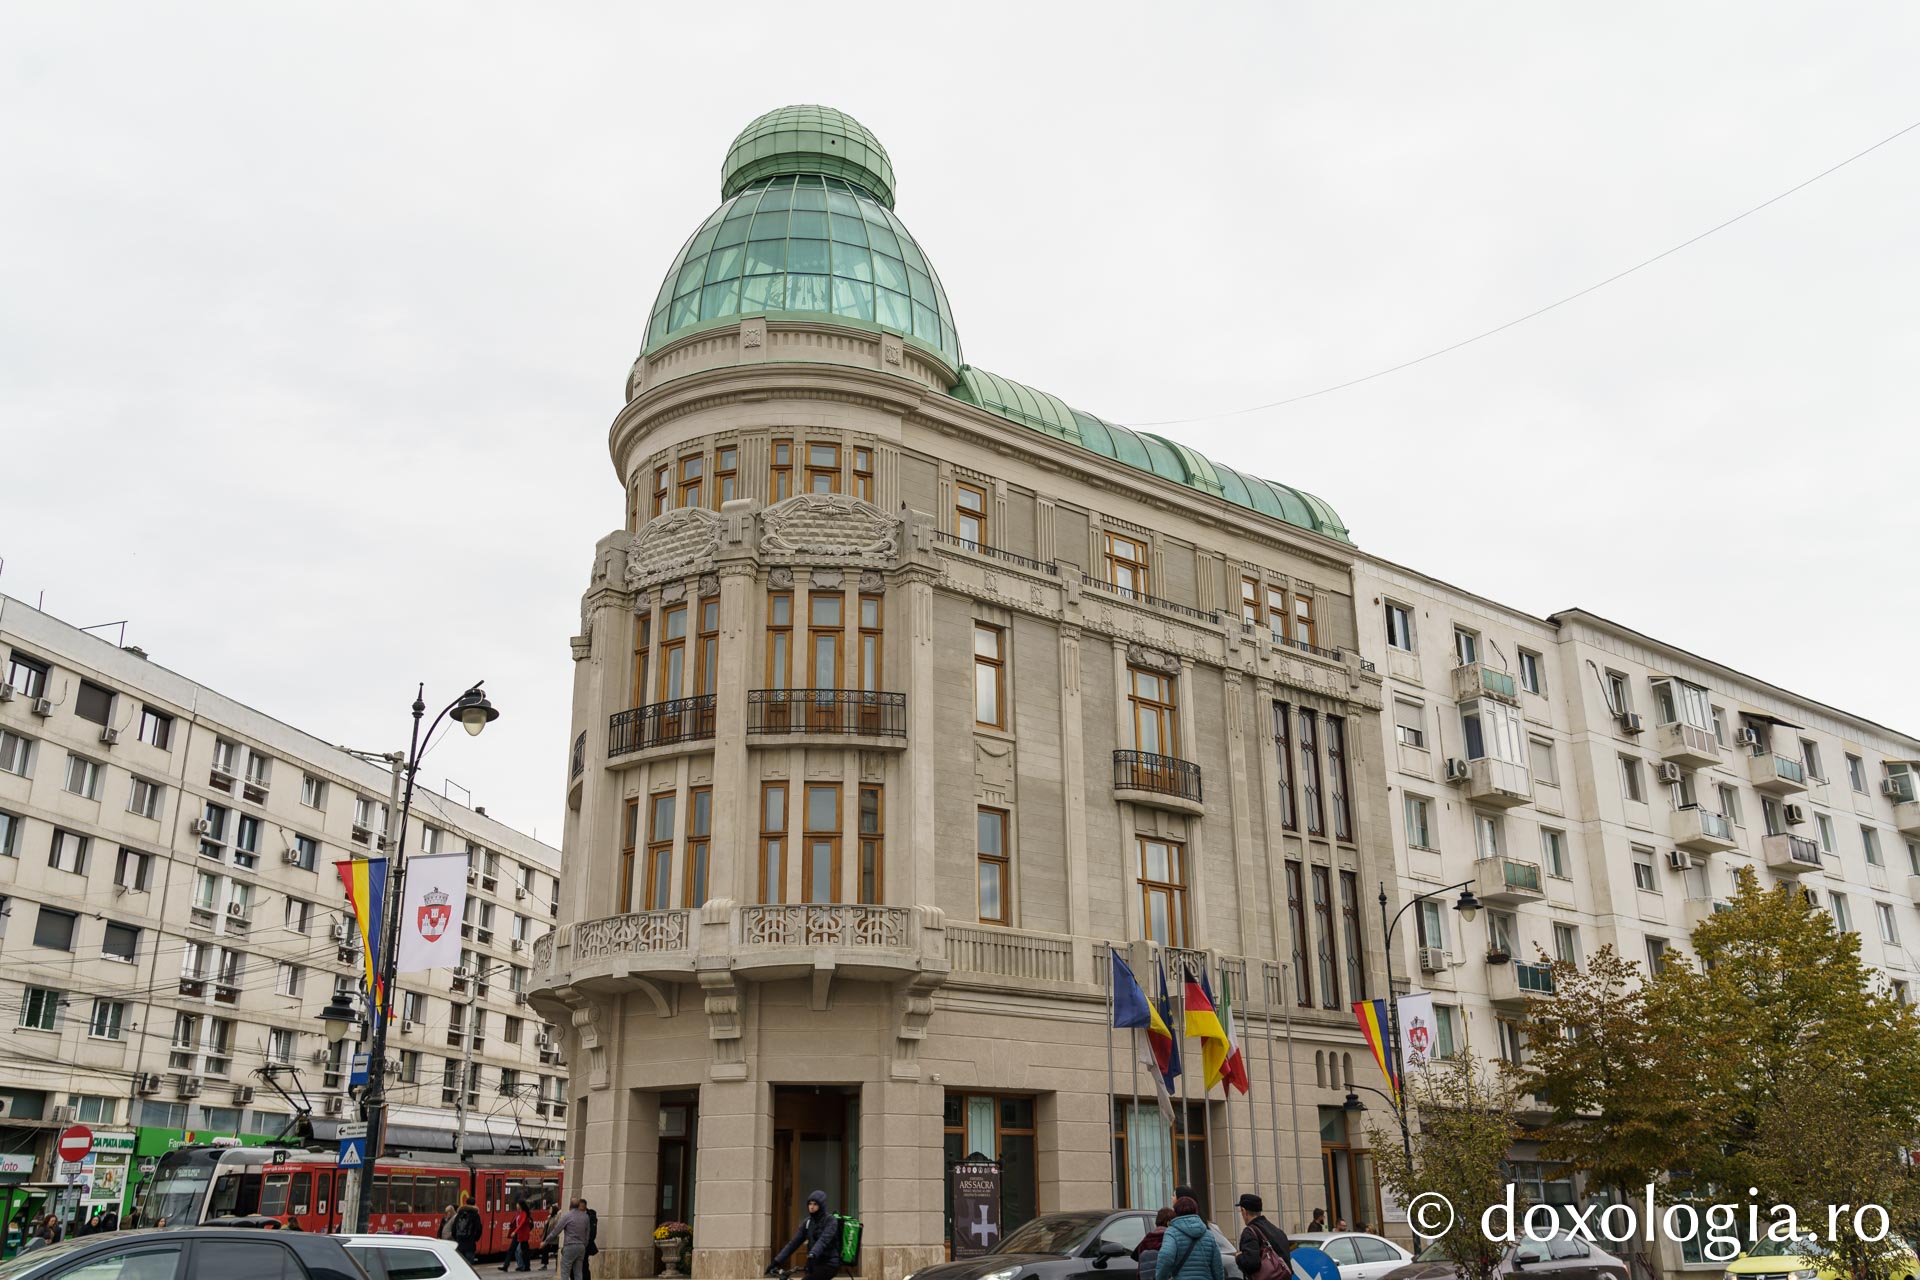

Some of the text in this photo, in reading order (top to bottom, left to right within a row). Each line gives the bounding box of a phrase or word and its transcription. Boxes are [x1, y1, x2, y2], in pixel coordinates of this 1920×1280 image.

[275, 1153, 284, 1163] 13
[959, 1180, 994, 1189] ARS SACRA
